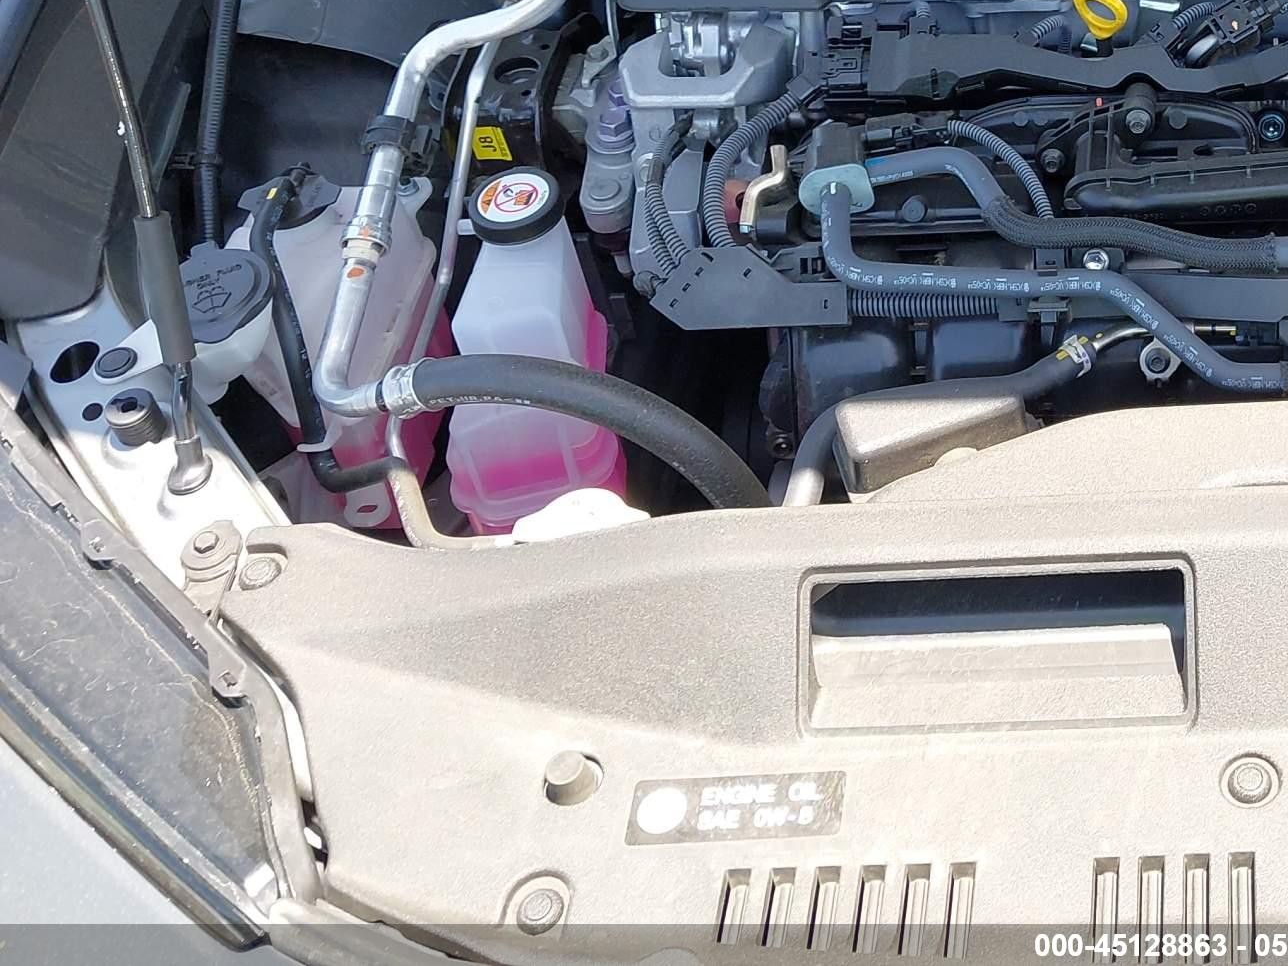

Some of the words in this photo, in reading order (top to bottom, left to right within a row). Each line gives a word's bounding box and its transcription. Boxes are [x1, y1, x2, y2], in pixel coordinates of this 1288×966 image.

[700, 784, 777, 806] ENGINE
[788, 782, 823, 802] OIL
[697, 809, 741, 831] SAE
